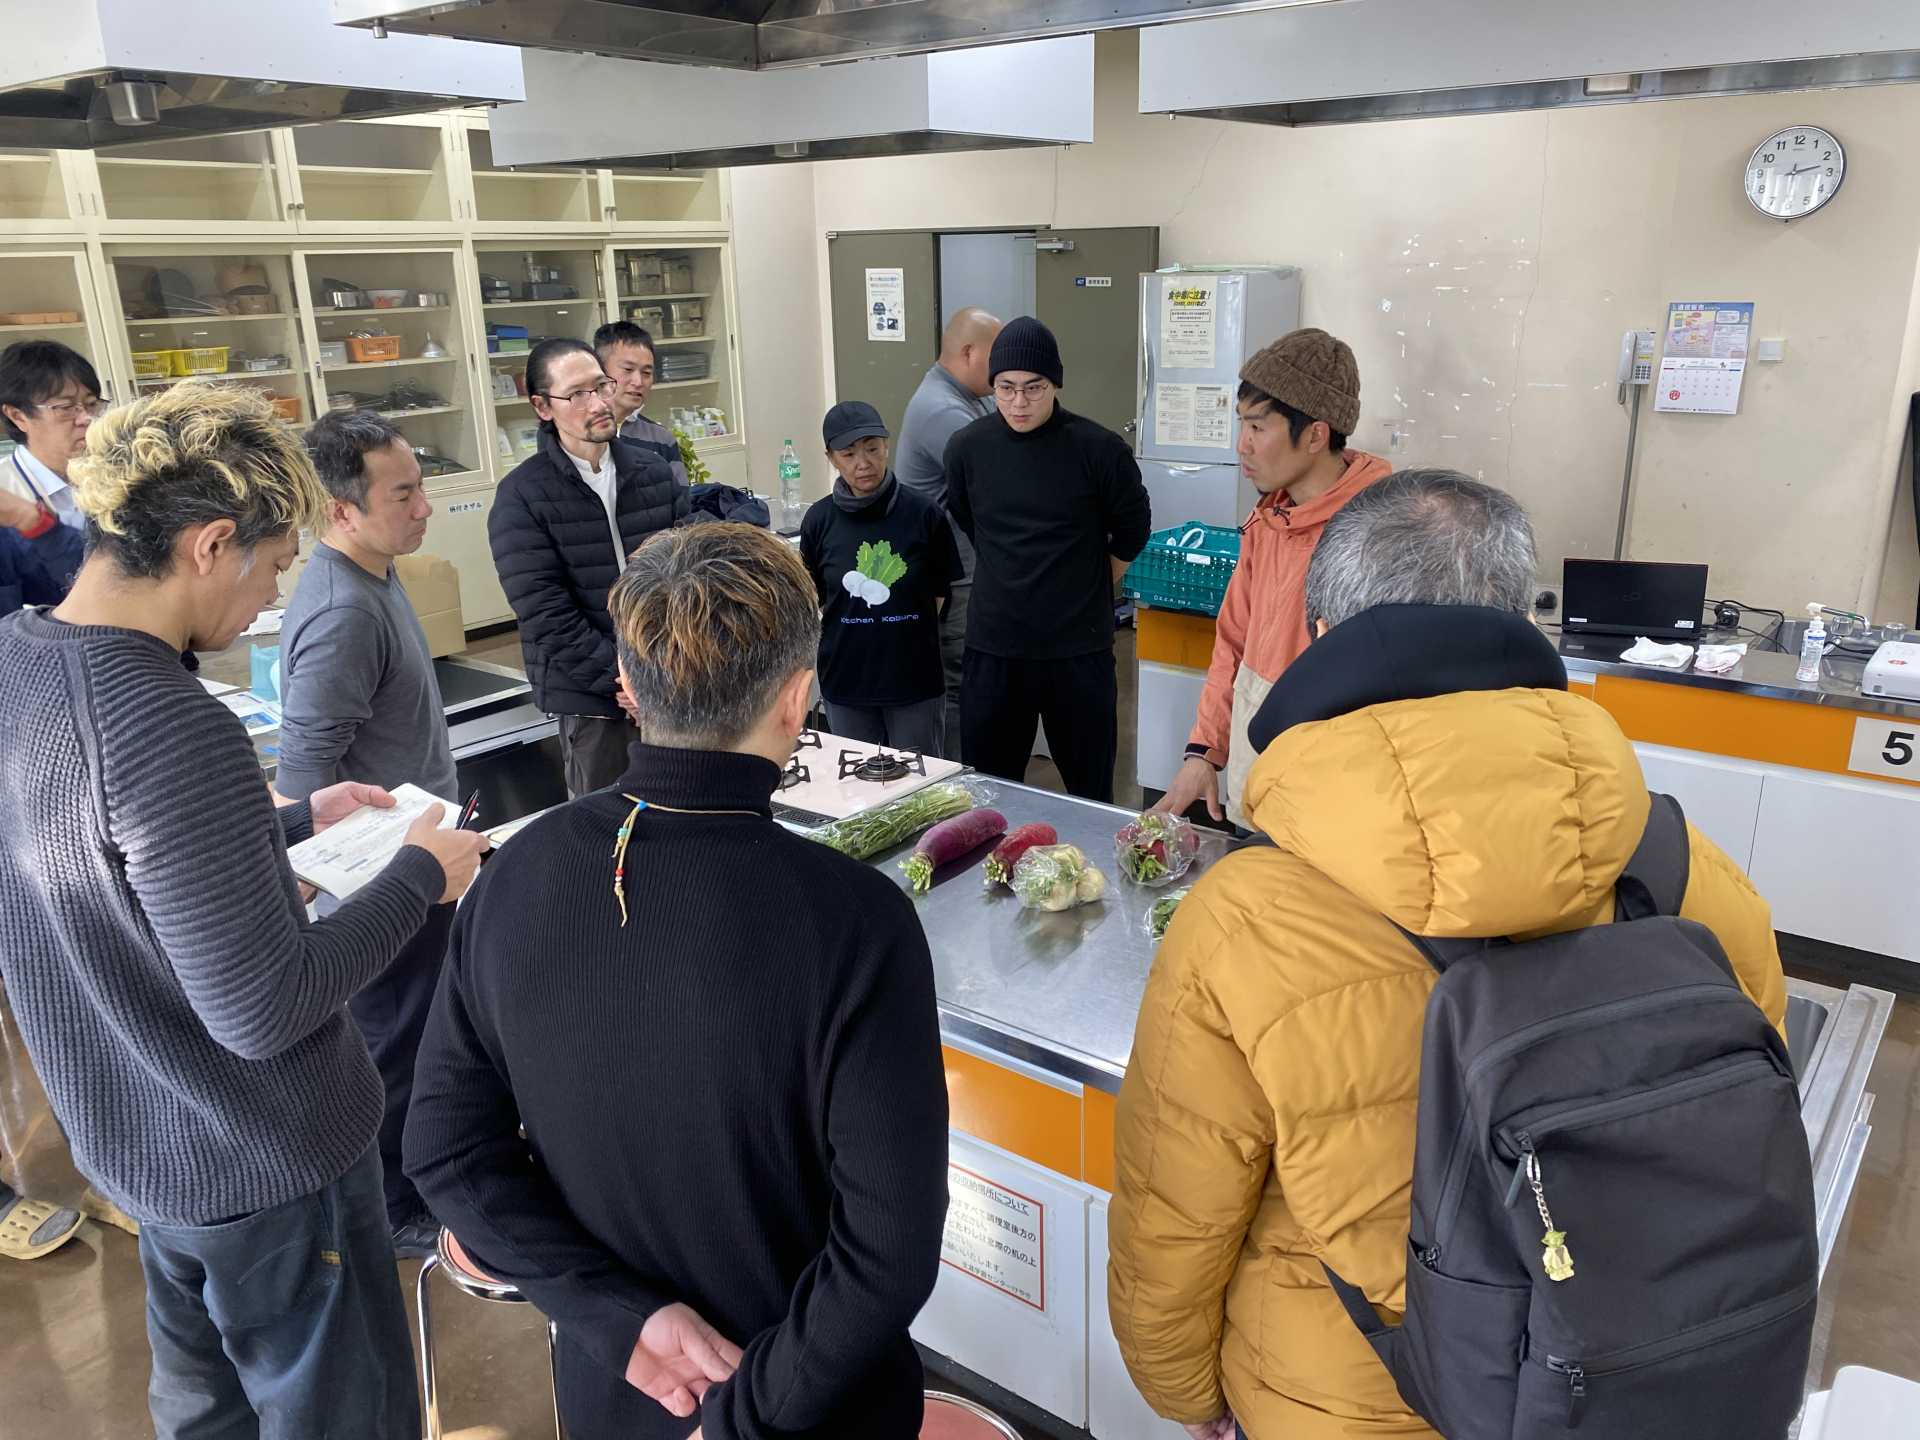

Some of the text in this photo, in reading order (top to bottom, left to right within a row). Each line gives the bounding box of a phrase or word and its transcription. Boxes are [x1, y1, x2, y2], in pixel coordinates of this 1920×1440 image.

[1794, 135, 1806, 145] 12
[1776, 141, 1786, 150] 11
[1762, 153, 1775, 163] 10
[1823, 151, 1831, 161] 2
[1757, 168, 1764, 179] 9
[1826, 167, 1834, 177] 3
[1758, 184, 1766, 194] 8
[1818, 184, 1824, 193] 4
[1769, 196, 1776, 206] 7
[1803, 195, 1811, 206] 5
[1882, 731, 1915, 765] 5
